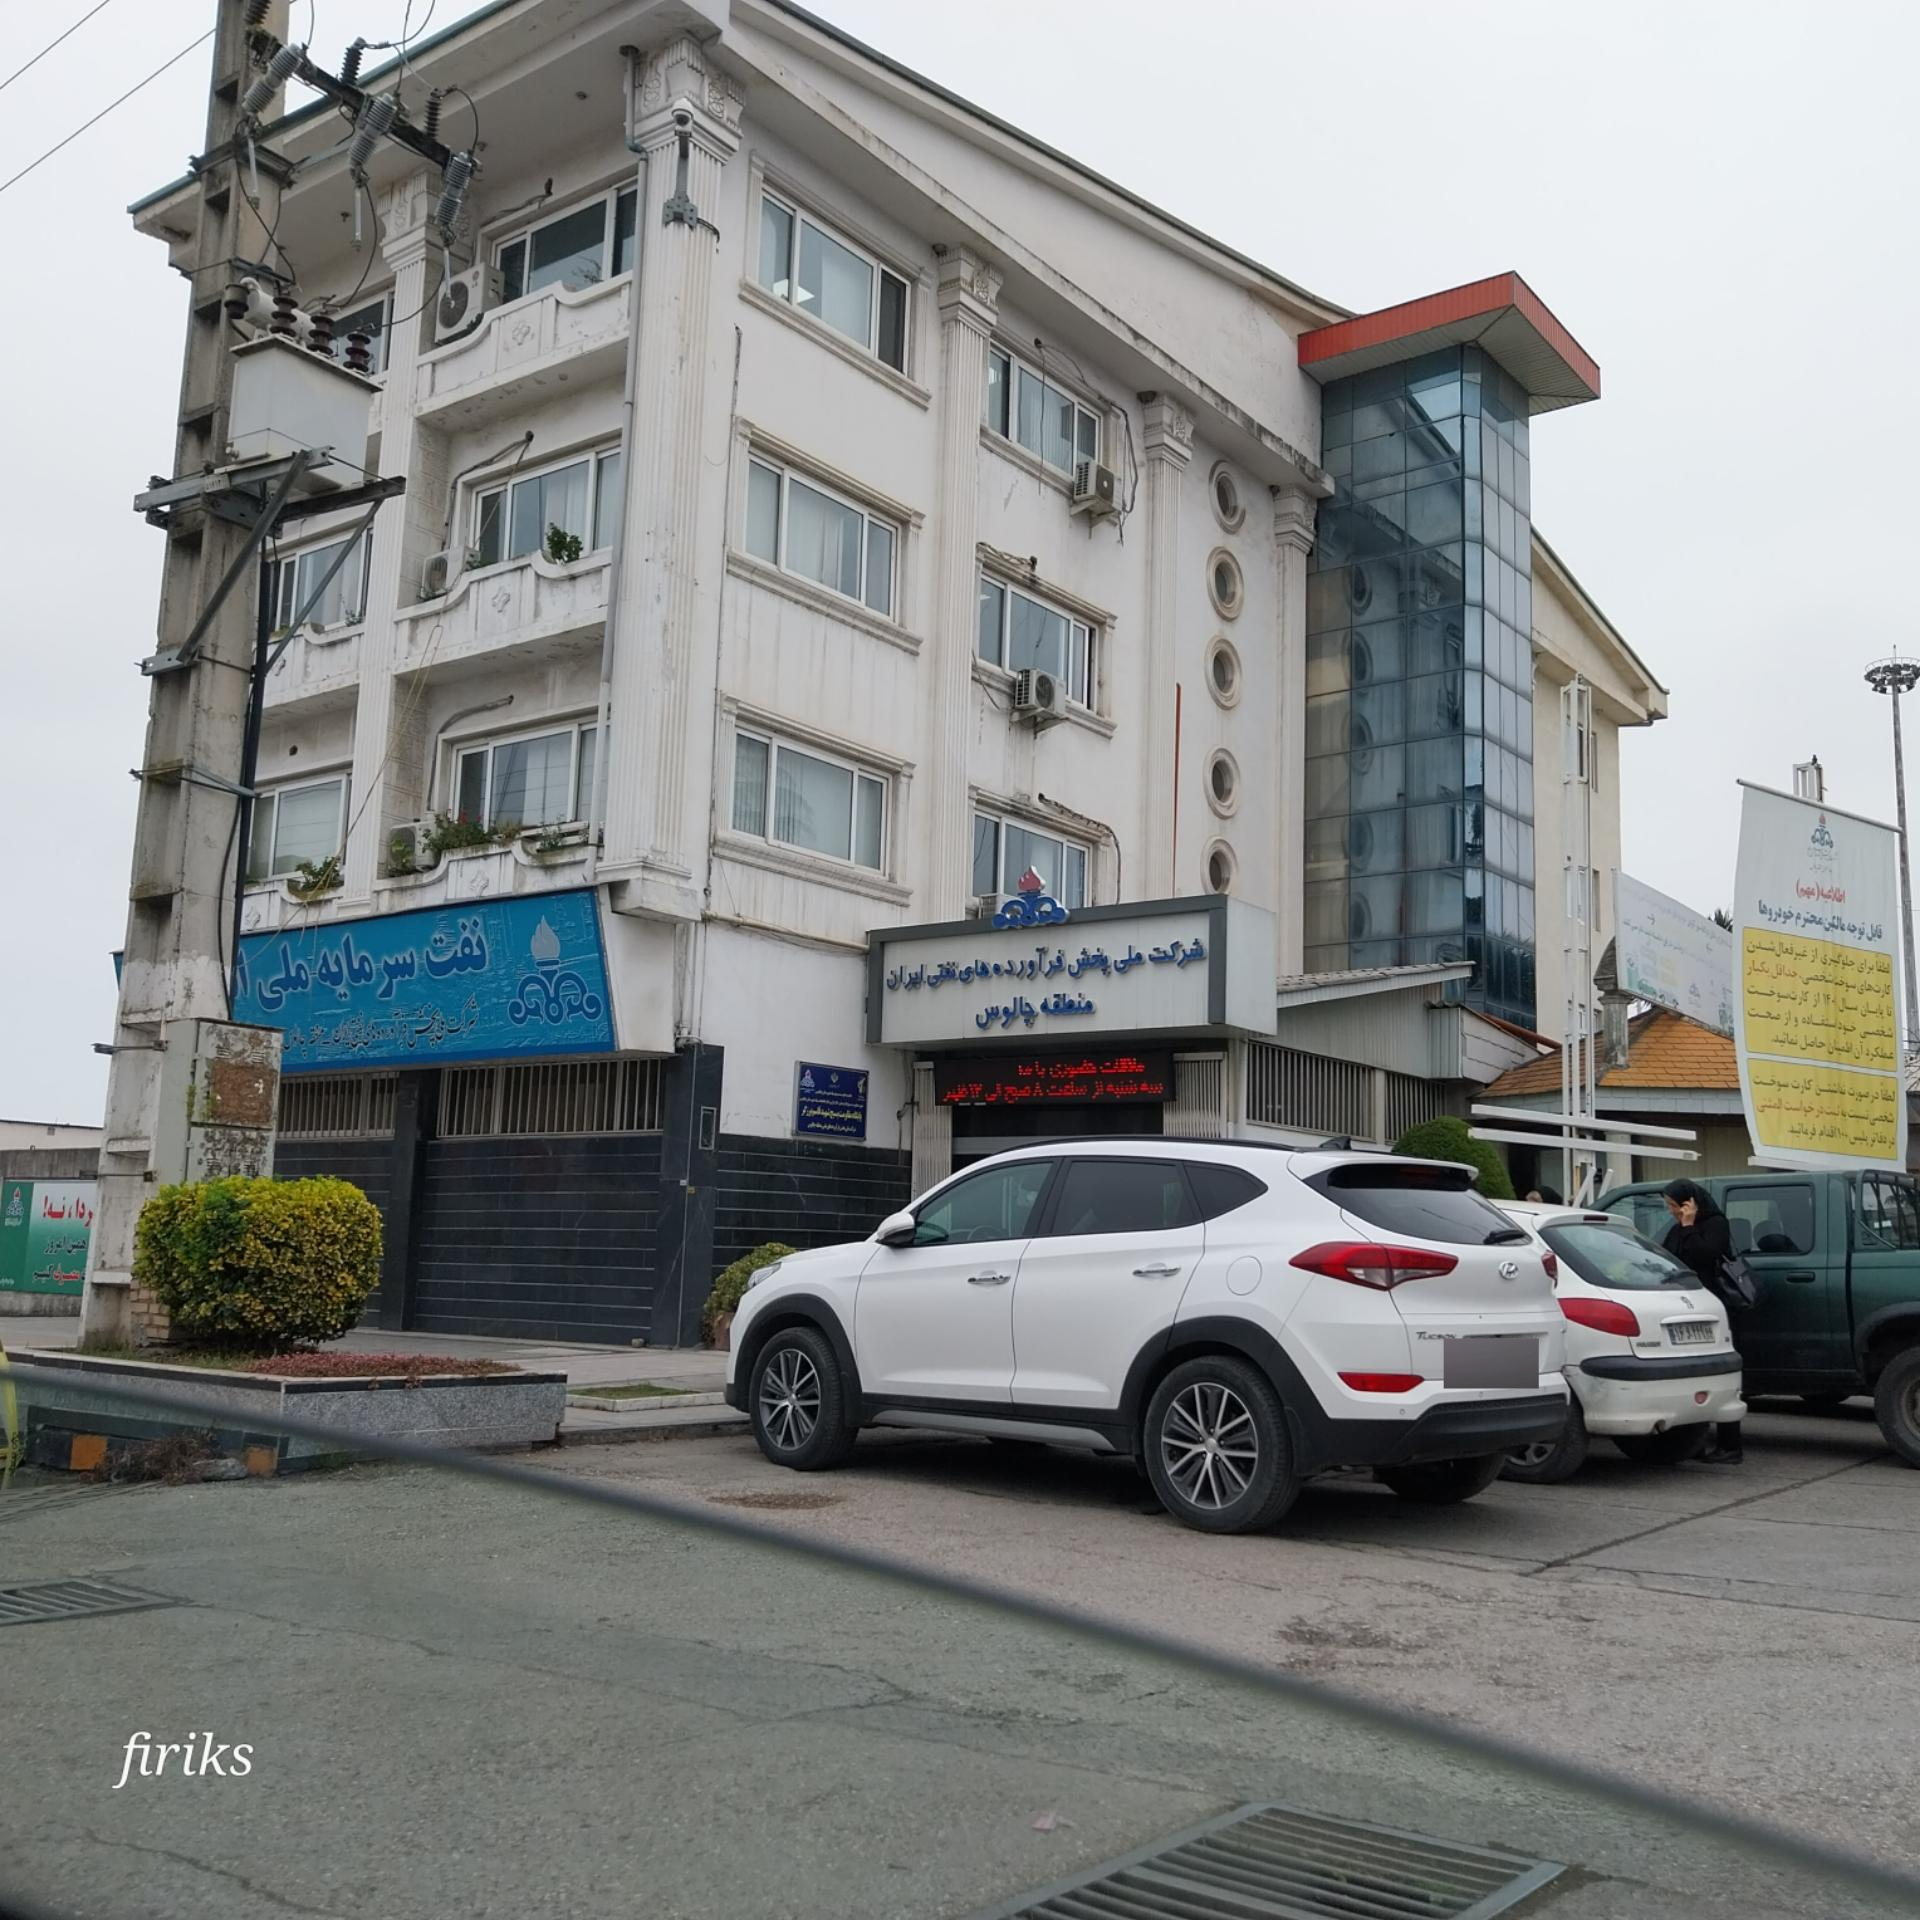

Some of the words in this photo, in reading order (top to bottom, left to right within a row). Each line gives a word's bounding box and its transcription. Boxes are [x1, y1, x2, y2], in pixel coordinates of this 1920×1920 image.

[1758, 900, 1794, 925] خودروها
[1795, 911, 1823, 928] محترم
[1823, 914, 1846, 933] مالکین
[1847, 921, 1866, 940] توجه
[1866, 923, 1883, 942] قابل
[426, 919, 488, 978] نفت
[1149, 938, 1207, 968] شرکت
[1810, 947, 1818, 963] از
[1068, 949, 1110, 979] پخش
[1113, 945, 1143, 975] ملی
[1820, 954, 1856, 972] جلوگیری
[1857, 959, 1875, 974] برای
[258, 943, 309, 1011] ملی
[886, 963, 924, 992] ایران
[926, 961, 958, 988] نفتی
[1039, 992, 1096, 1017] منطقه
[1812, 991, 1820, 1008] از
[1839, 997, 1858, 1013] سال
[975, 995, 1039, 1031] چالوس
[1747, 1008, 1781, 1020] صحت
[1860, 1001, 1884, 1020] پایان
[1859, 1026, 1893, 1039] شخصی
[1799, 1034, 1826, 1051] حاصل
[1853, 1040, 1863, 1060] آن
[1865, 1045, 1895, 1061] عملکرد
[1753, 1074, 1789, 1092] سوخت
[1791, 1077, 1814, 1095] کارت
[1847, 1087, 1869, 1102] صورت
[1869, 1091, 1880, 1104] در
[1869, 1111, 1894, 1126] شخصی
